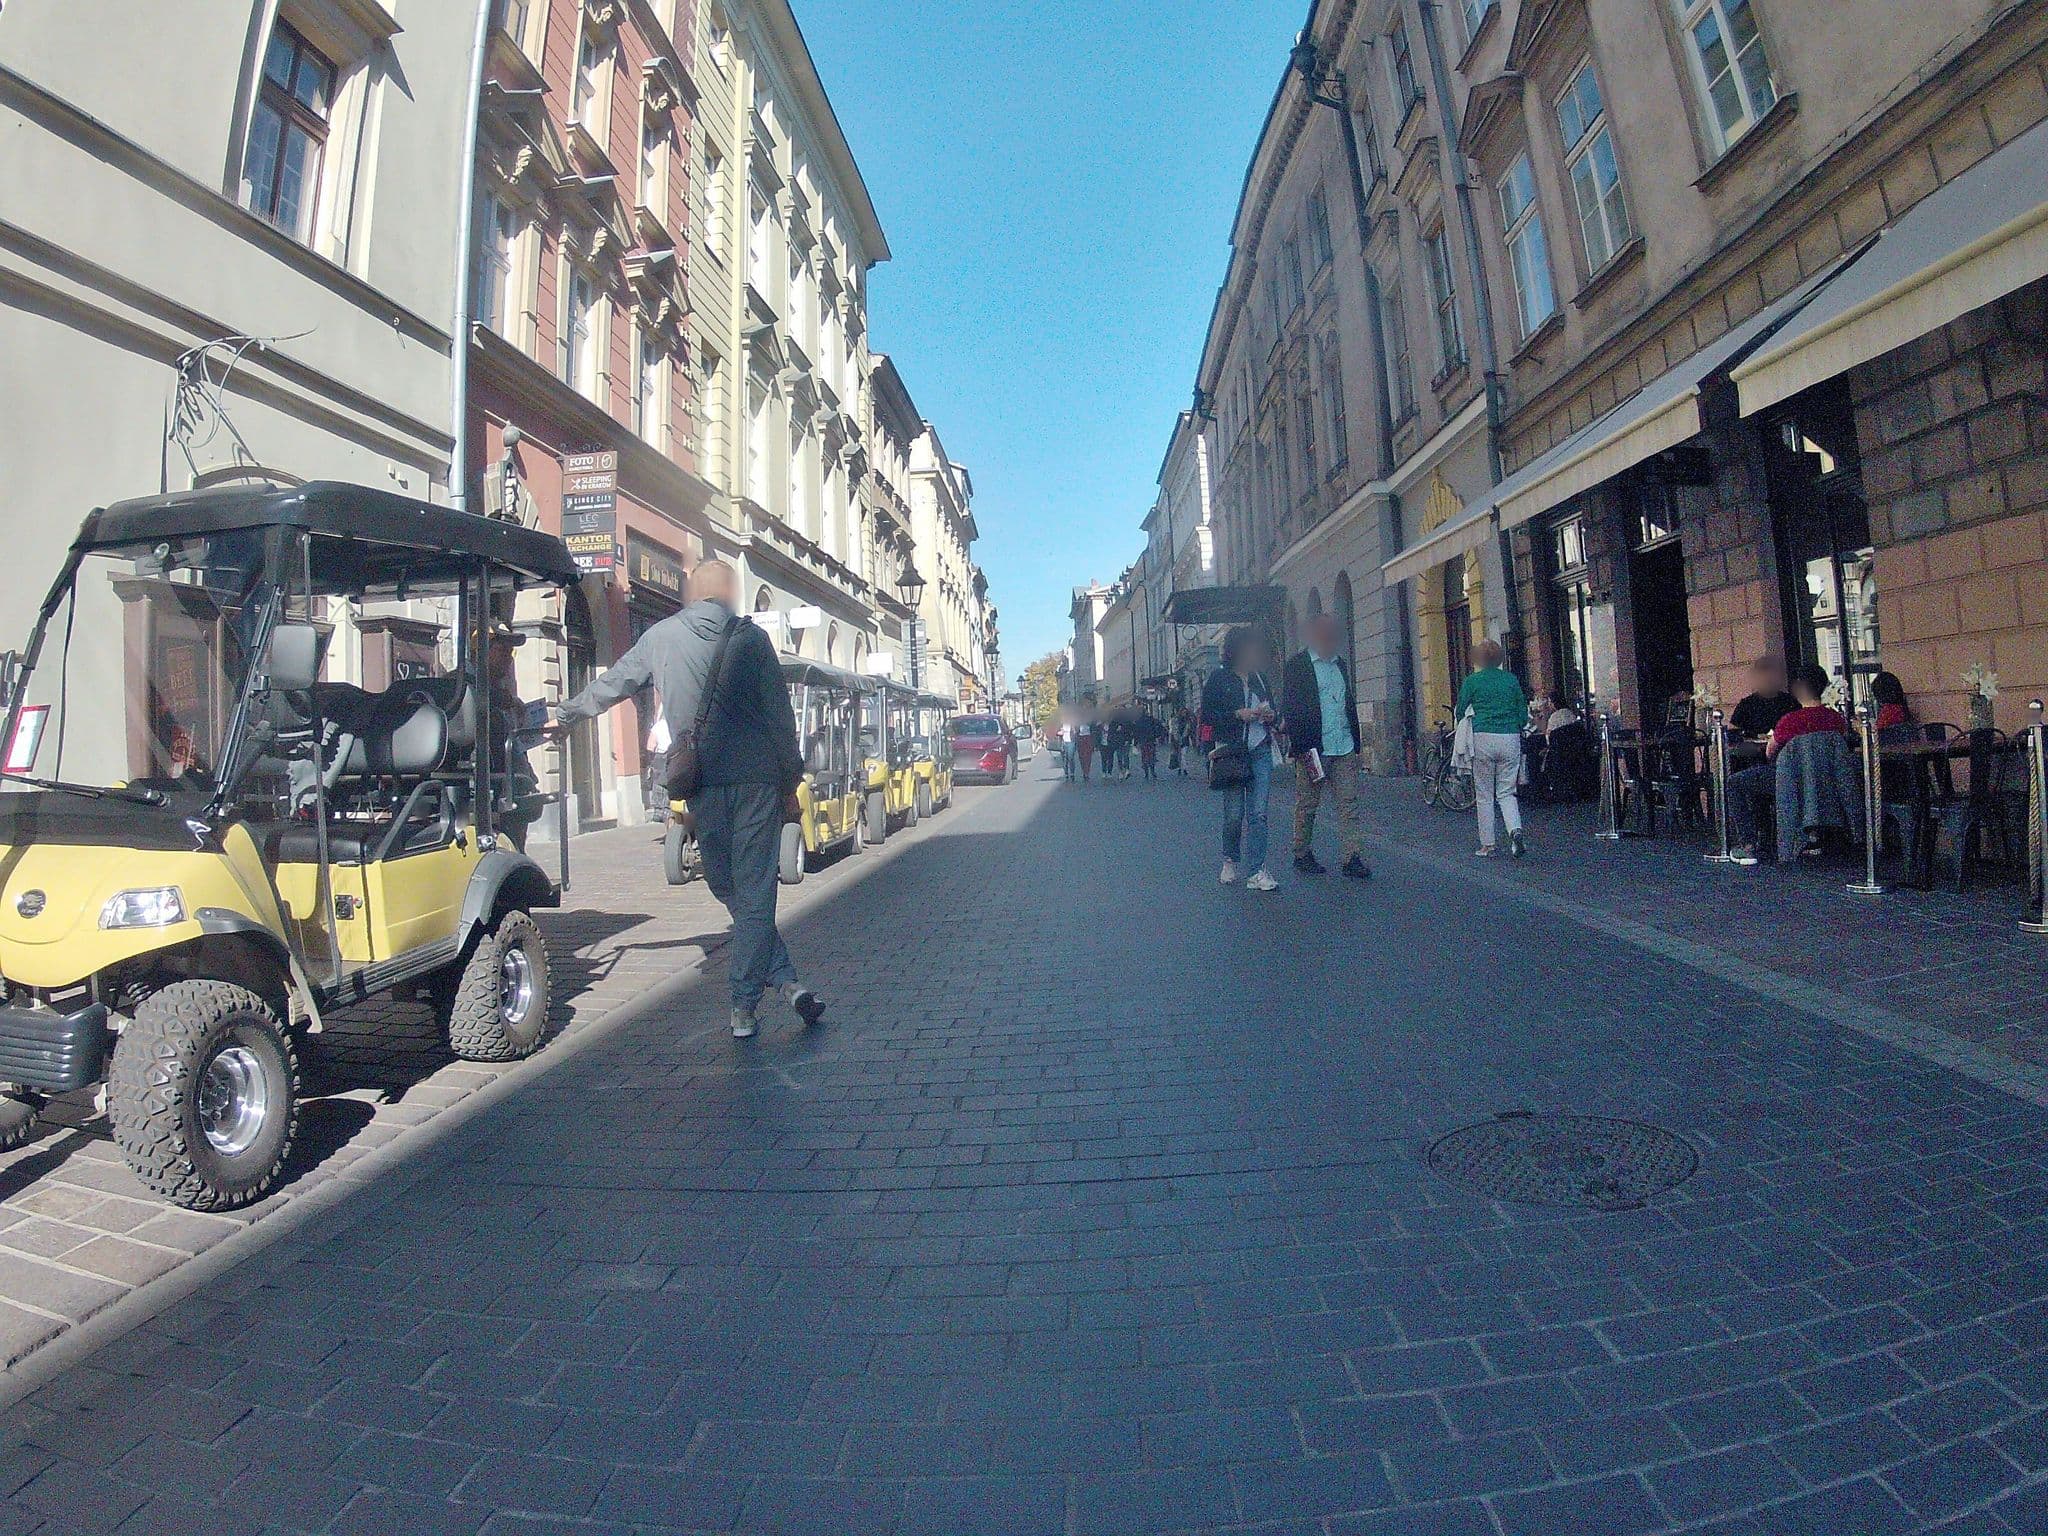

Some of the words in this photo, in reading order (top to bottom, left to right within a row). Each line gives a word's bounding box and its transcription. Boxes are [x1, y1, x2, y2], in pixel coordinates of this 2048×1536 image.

[569, 456, 593, 466] FOTO
[582, 475, 611, 484] SLEEPING
[568, 535, 611, 544] KANTOR
[572, 556, 592, 568] REE
